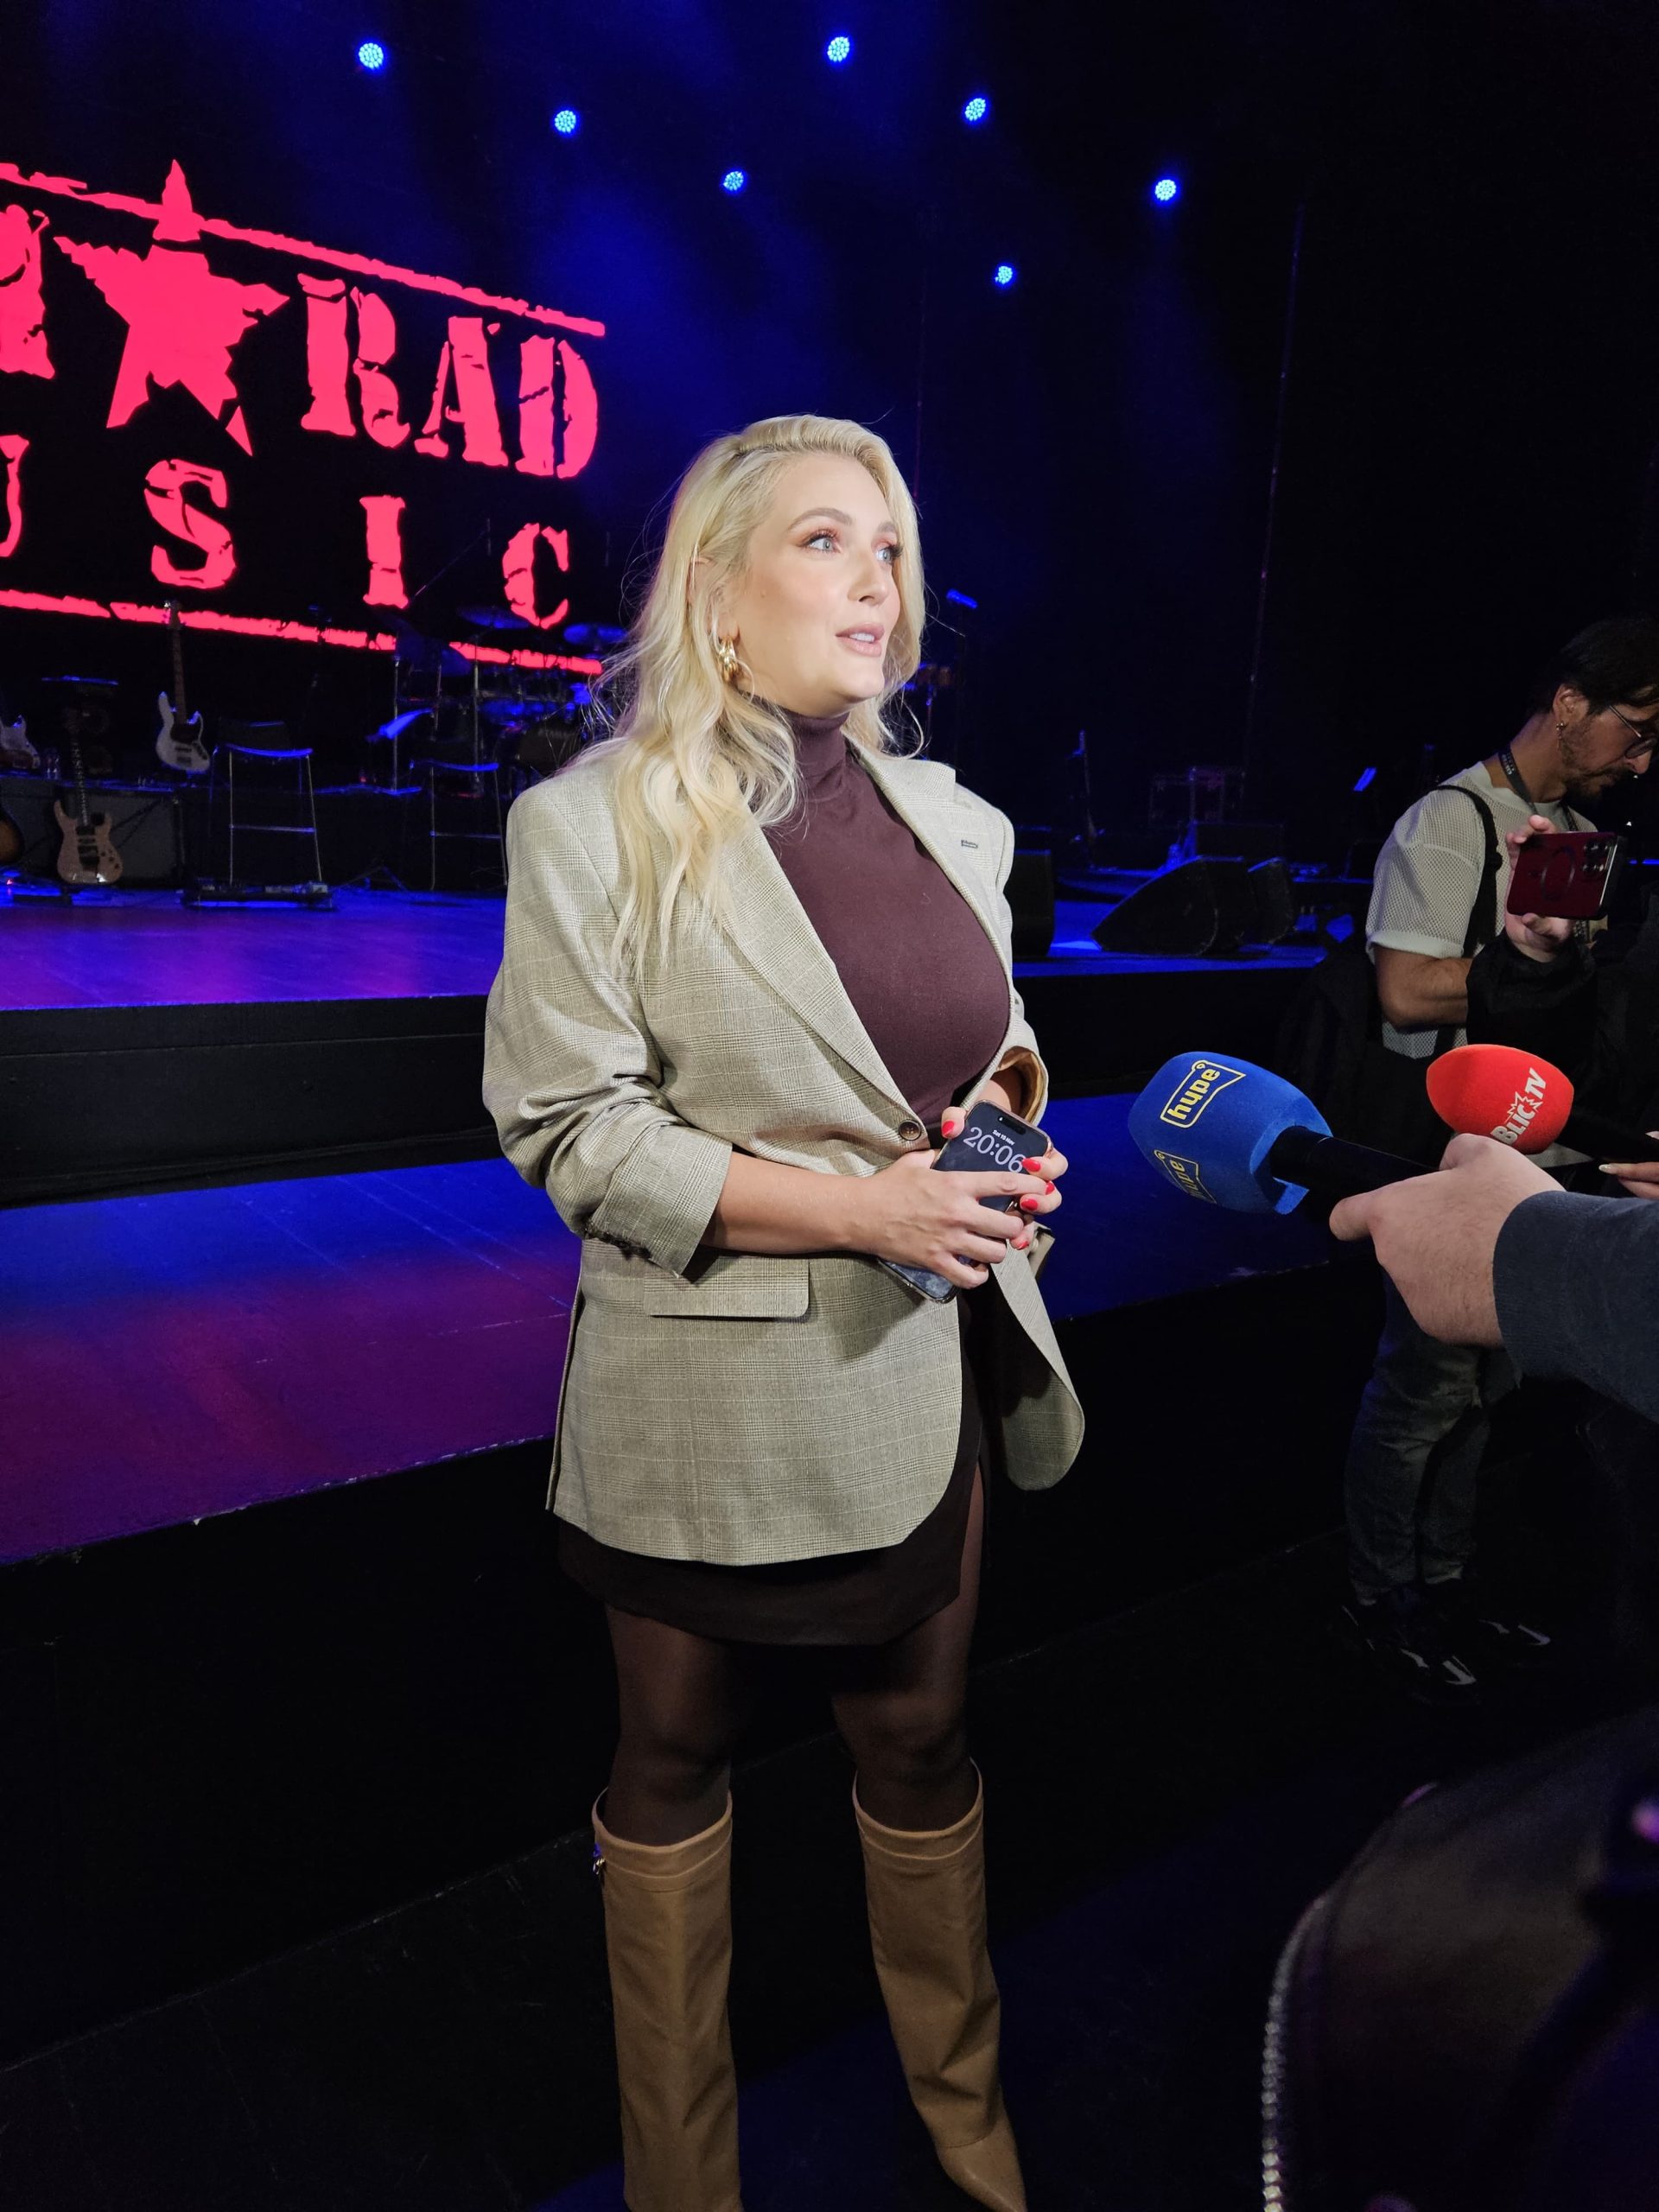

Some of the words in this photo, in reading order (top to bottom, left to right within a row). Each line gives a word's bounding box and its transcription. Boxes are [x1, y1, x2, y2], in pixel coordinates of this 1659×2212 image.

[298, 274, 597, 478] RAD
[1166, 1068, 1220, 1120] hype
[1490, 1103, 1535, 1145] BLIC
[1525, 1067, 1546, 1099] TV
[963, 1127, 1026, 1173] 20:06
